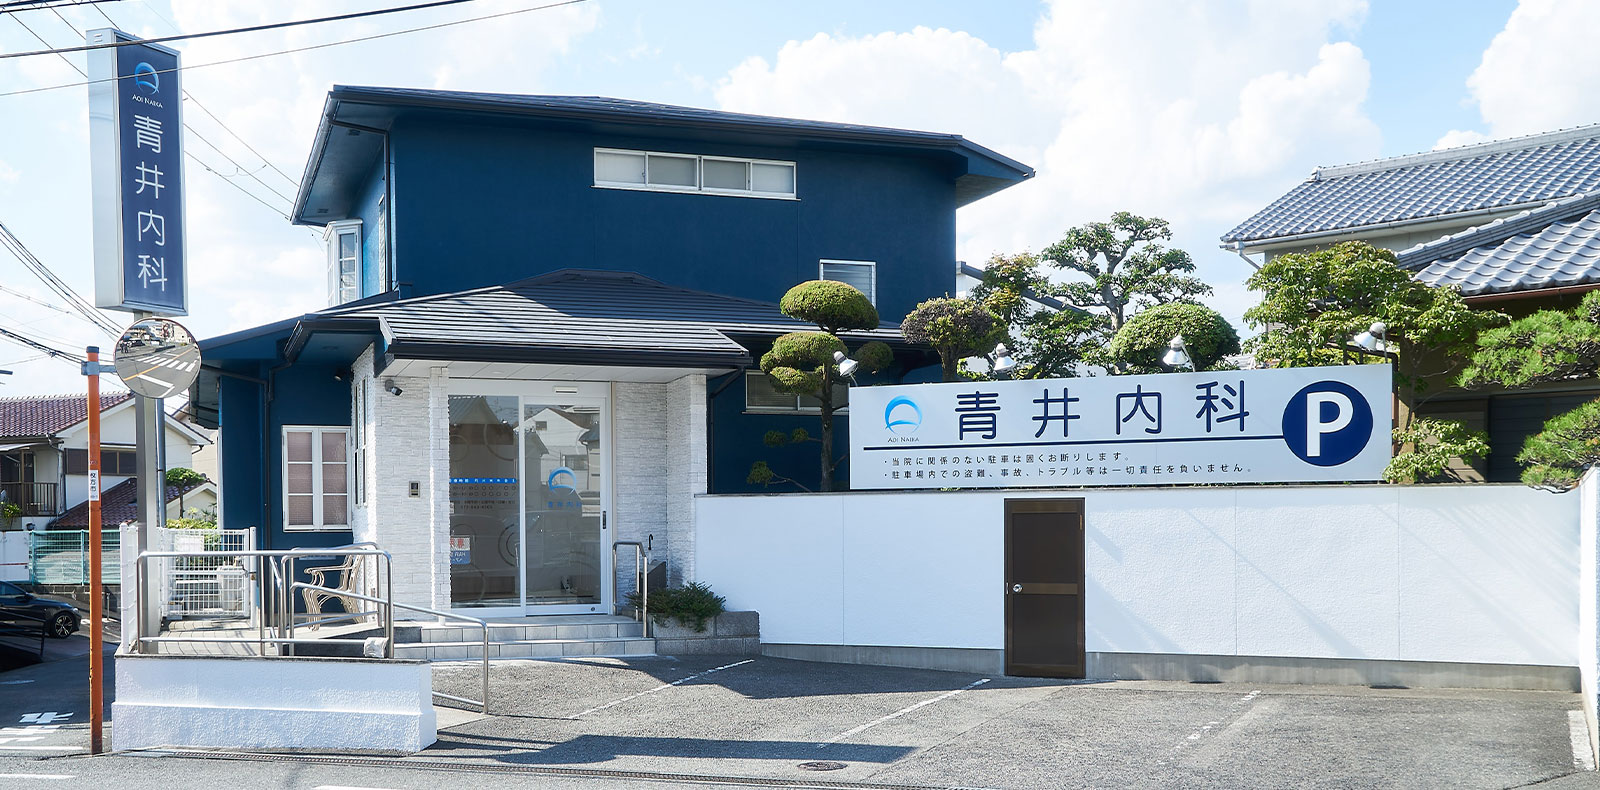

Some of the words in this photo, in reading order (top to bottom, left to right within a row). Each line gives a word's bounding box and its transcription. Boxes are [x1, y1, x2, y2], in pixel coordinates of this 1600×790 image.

[144, 97, 164, 109] NAIKA
[133, 114, 168, 292] 青井内科
[954, 379, 1250, 441] 青井内科
[1306, 391, 1354, 457] P
